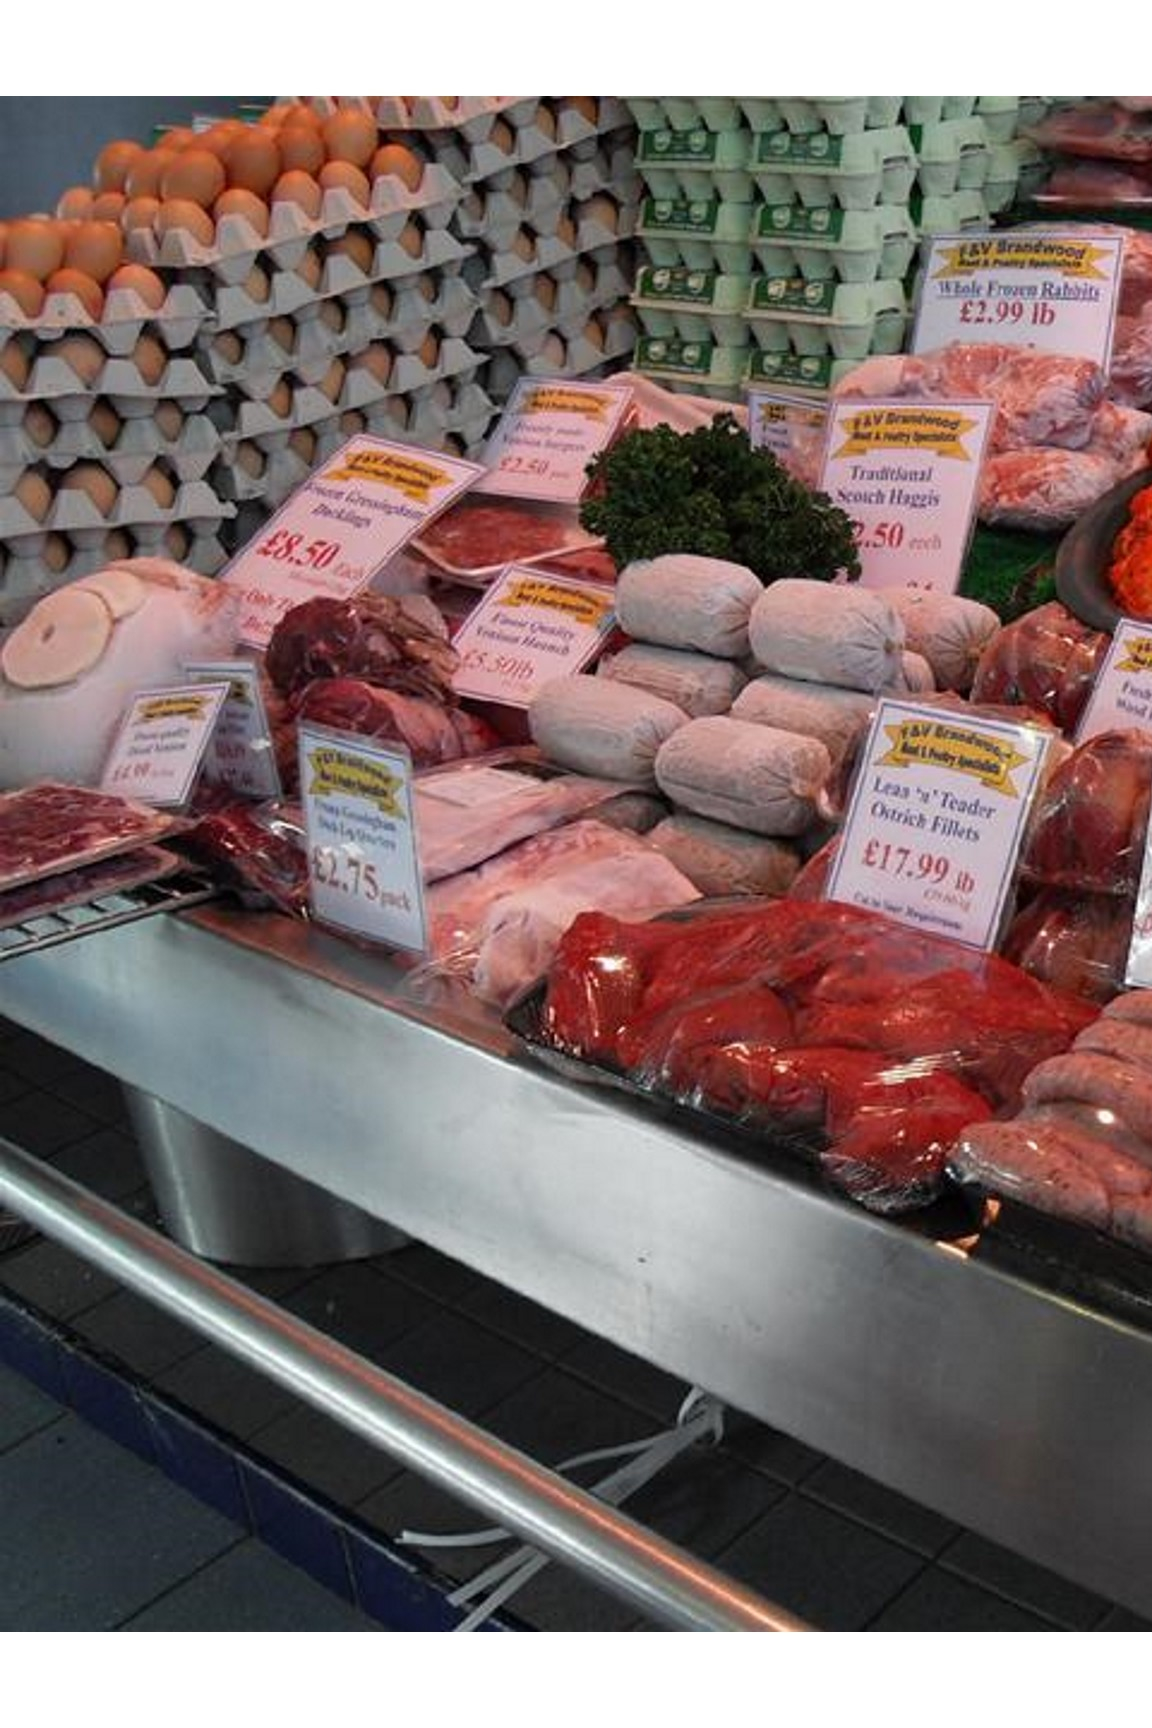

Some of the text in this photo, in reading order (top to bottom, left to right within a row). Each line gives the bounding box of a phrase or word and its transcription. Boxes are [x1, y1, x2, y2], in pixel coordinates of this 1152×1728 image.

[997, 239, 1086, 259] Brandwood
[939, 279, 1100, 301] Whole Frozen Rabbits
[959, 300, 1056, 325] £2.99 lb
[884, 411, 961, 430] Brandwood
[849, 465, 934, 483] Traditional
[837, 488, 942, 509] Scotch Haggis
[851, 519, 905, 549] 2.50
[256, 528, 341, 568] £8.50
[873, 776, 910, 799] Lean
[940, 790, 997, 821] Tender
[870, 800, 980, 843] Ostrich Fillets
[312, 844, 381, 901] £2.75
[861, 838, 976, 893] £17.99 lb
